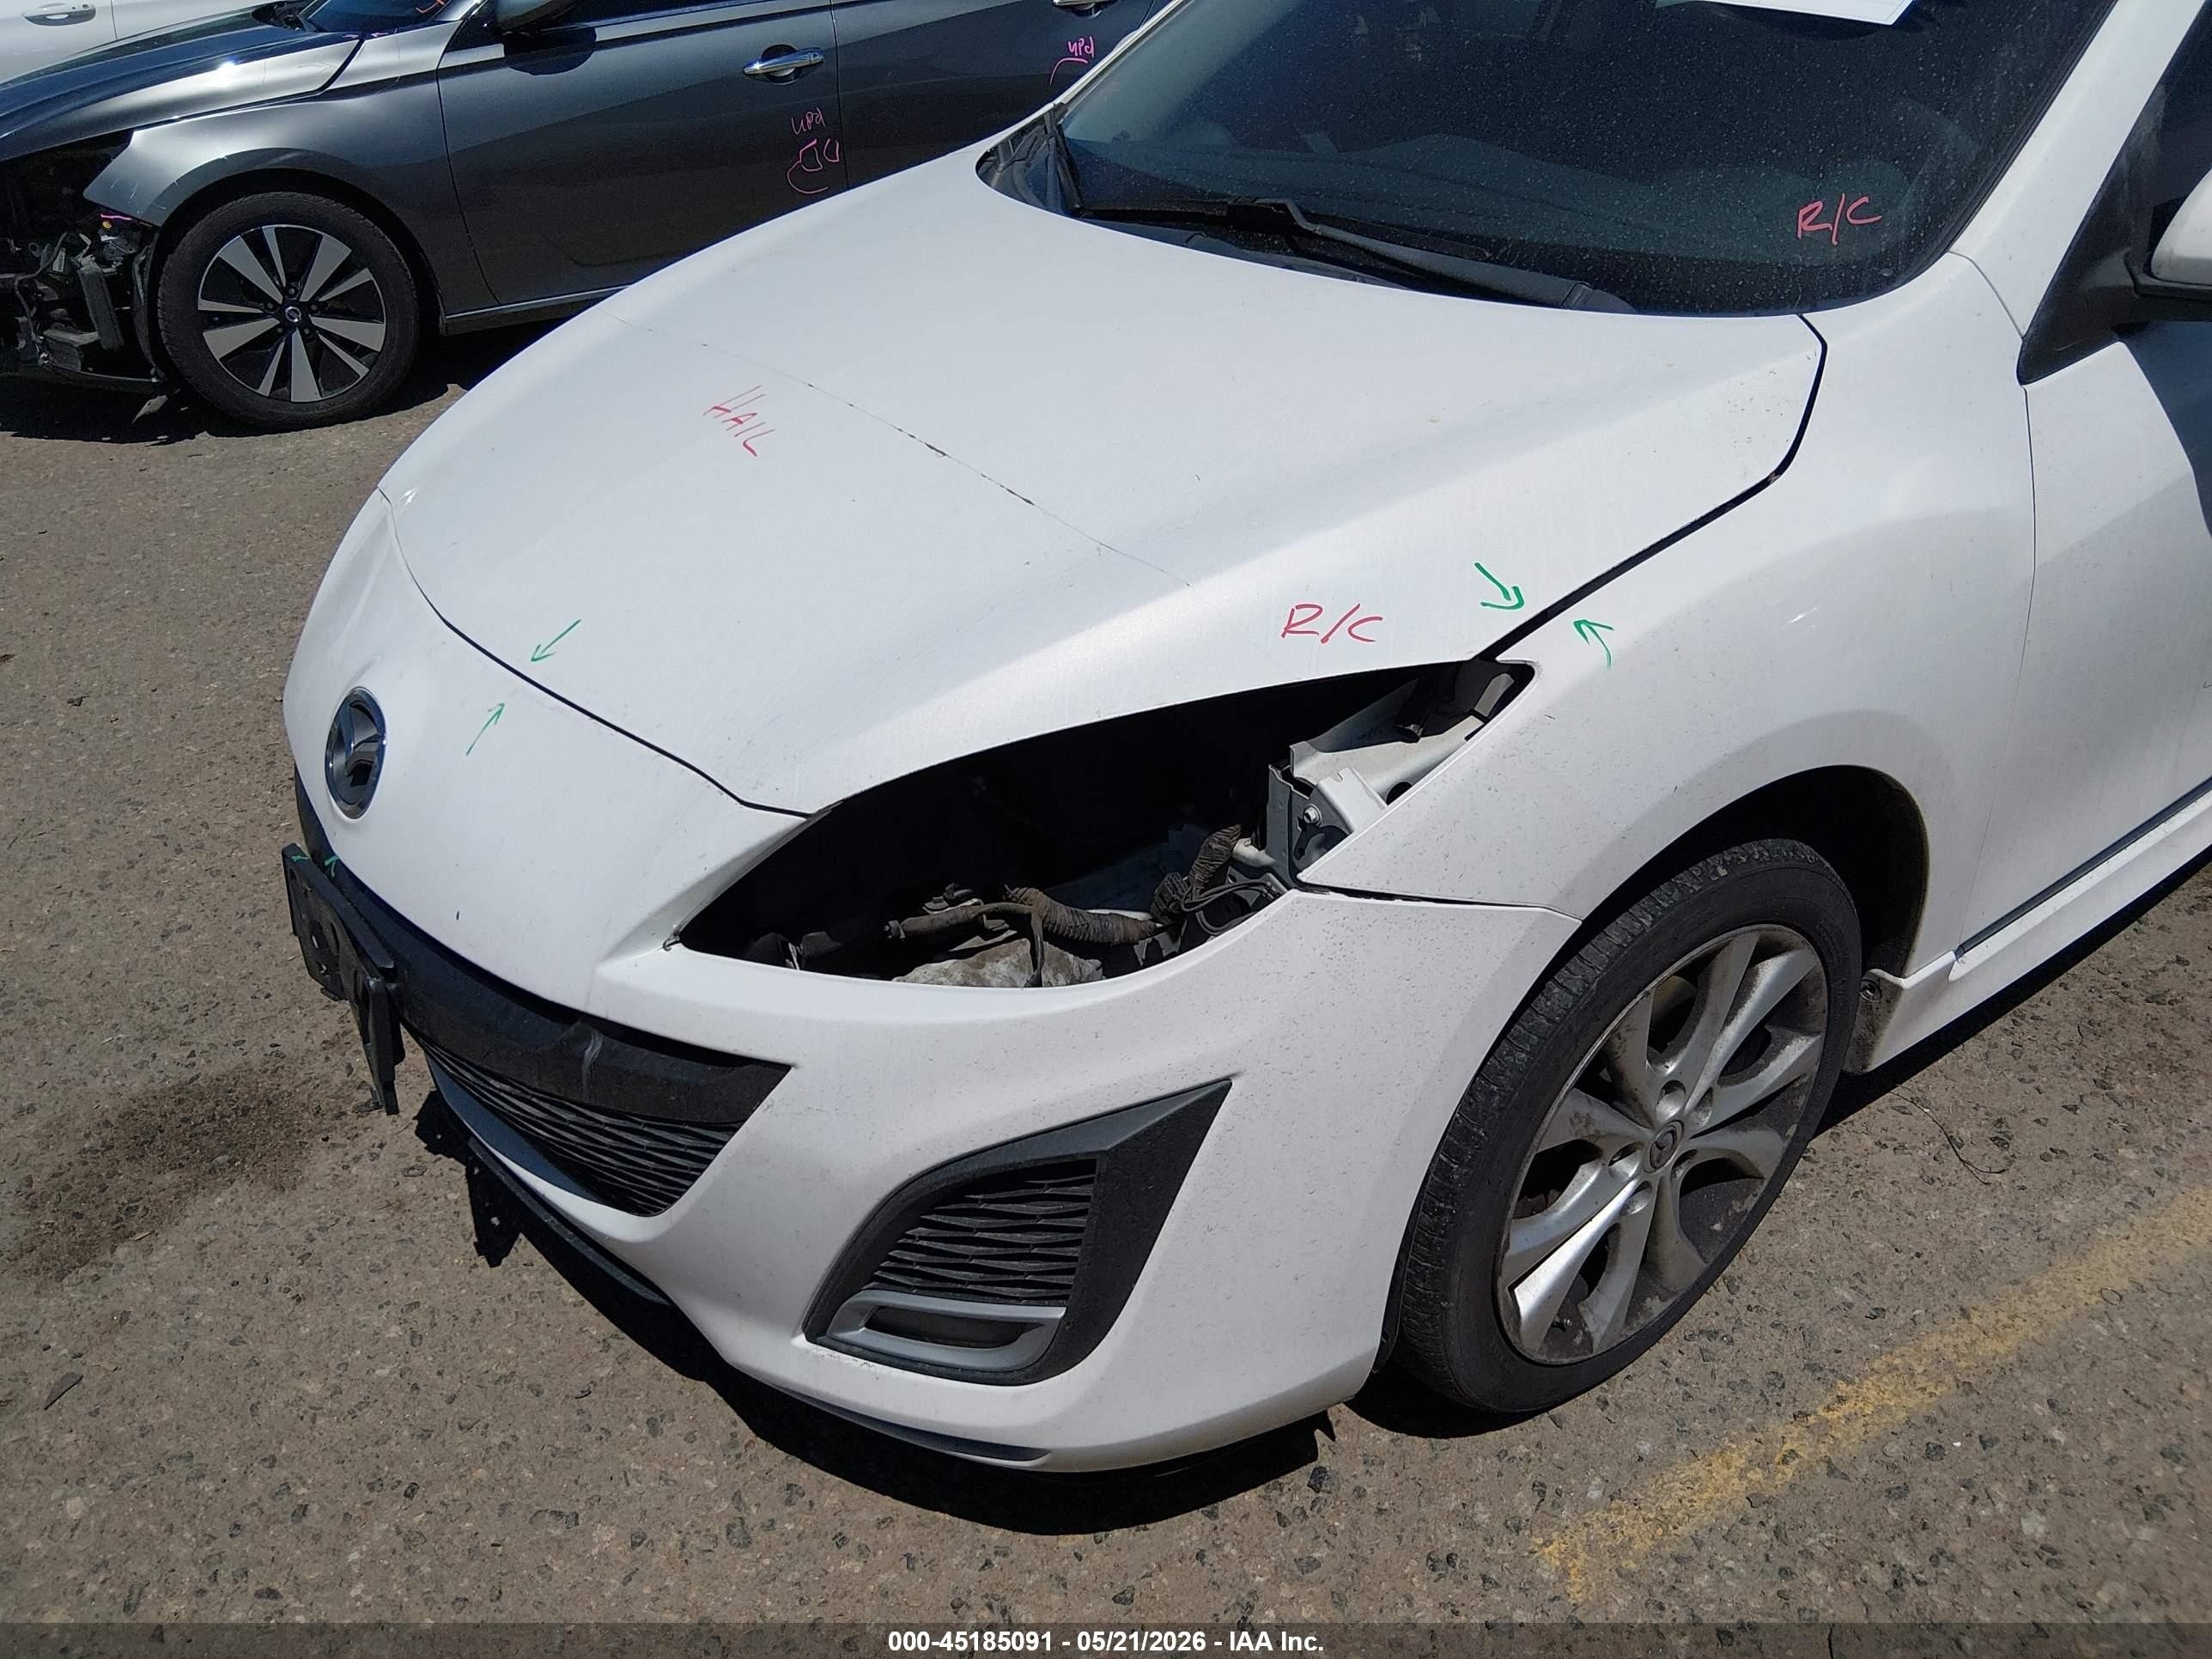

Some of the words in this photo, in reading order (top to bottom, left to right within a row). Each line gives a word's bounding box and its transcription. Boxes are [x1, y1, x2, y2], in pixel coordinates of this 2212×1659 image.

[1797, 192, 1882, 246] R/C
[702, 384, 775, 458] HAIL
[1280, 603, 1383, 645] R/C
